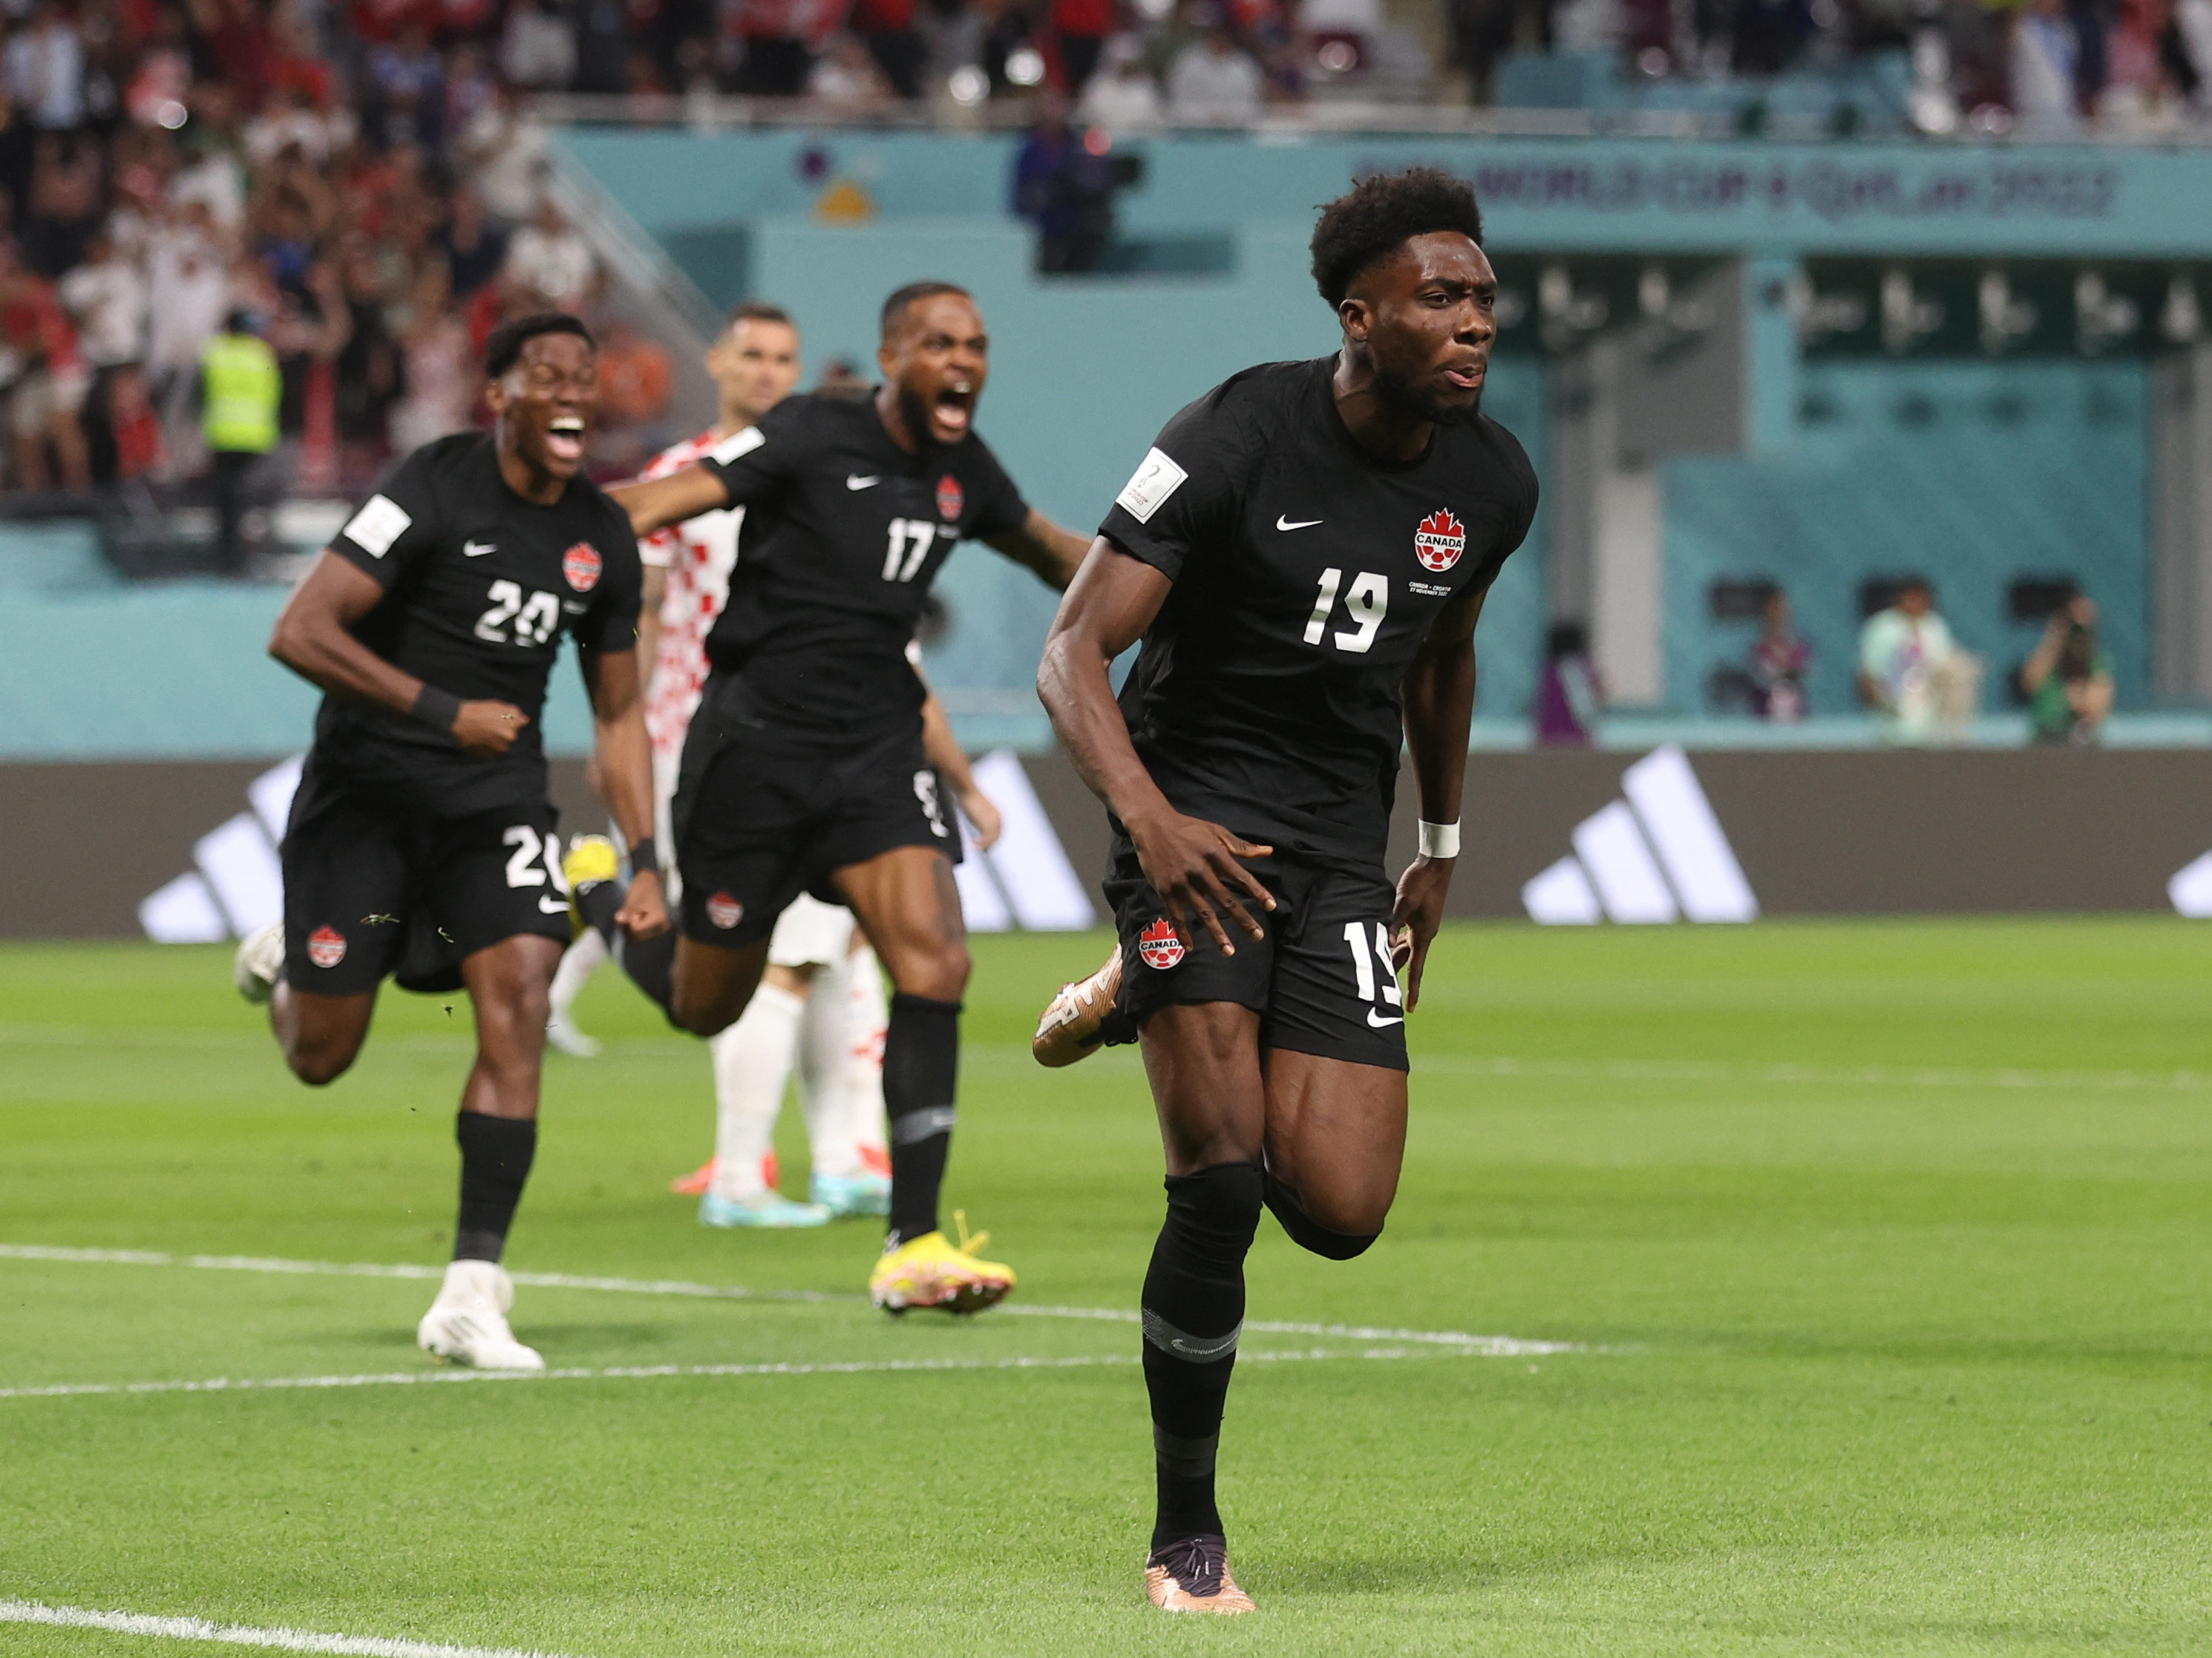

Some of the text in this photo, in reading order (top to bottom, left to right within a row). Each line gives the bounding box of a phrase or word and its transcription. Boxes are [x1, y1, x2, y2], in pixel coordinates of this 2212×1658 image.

[881, 517, 936, 582] 17
[1416, 534, 1462, 548] CANADA
[1409, 581, 1429, 590] CANADA
[1416, 587, 1438, 596] NOVEMBER
[474, 578, 560, 648] 20
[1303, 567, 1388, 653] 19
